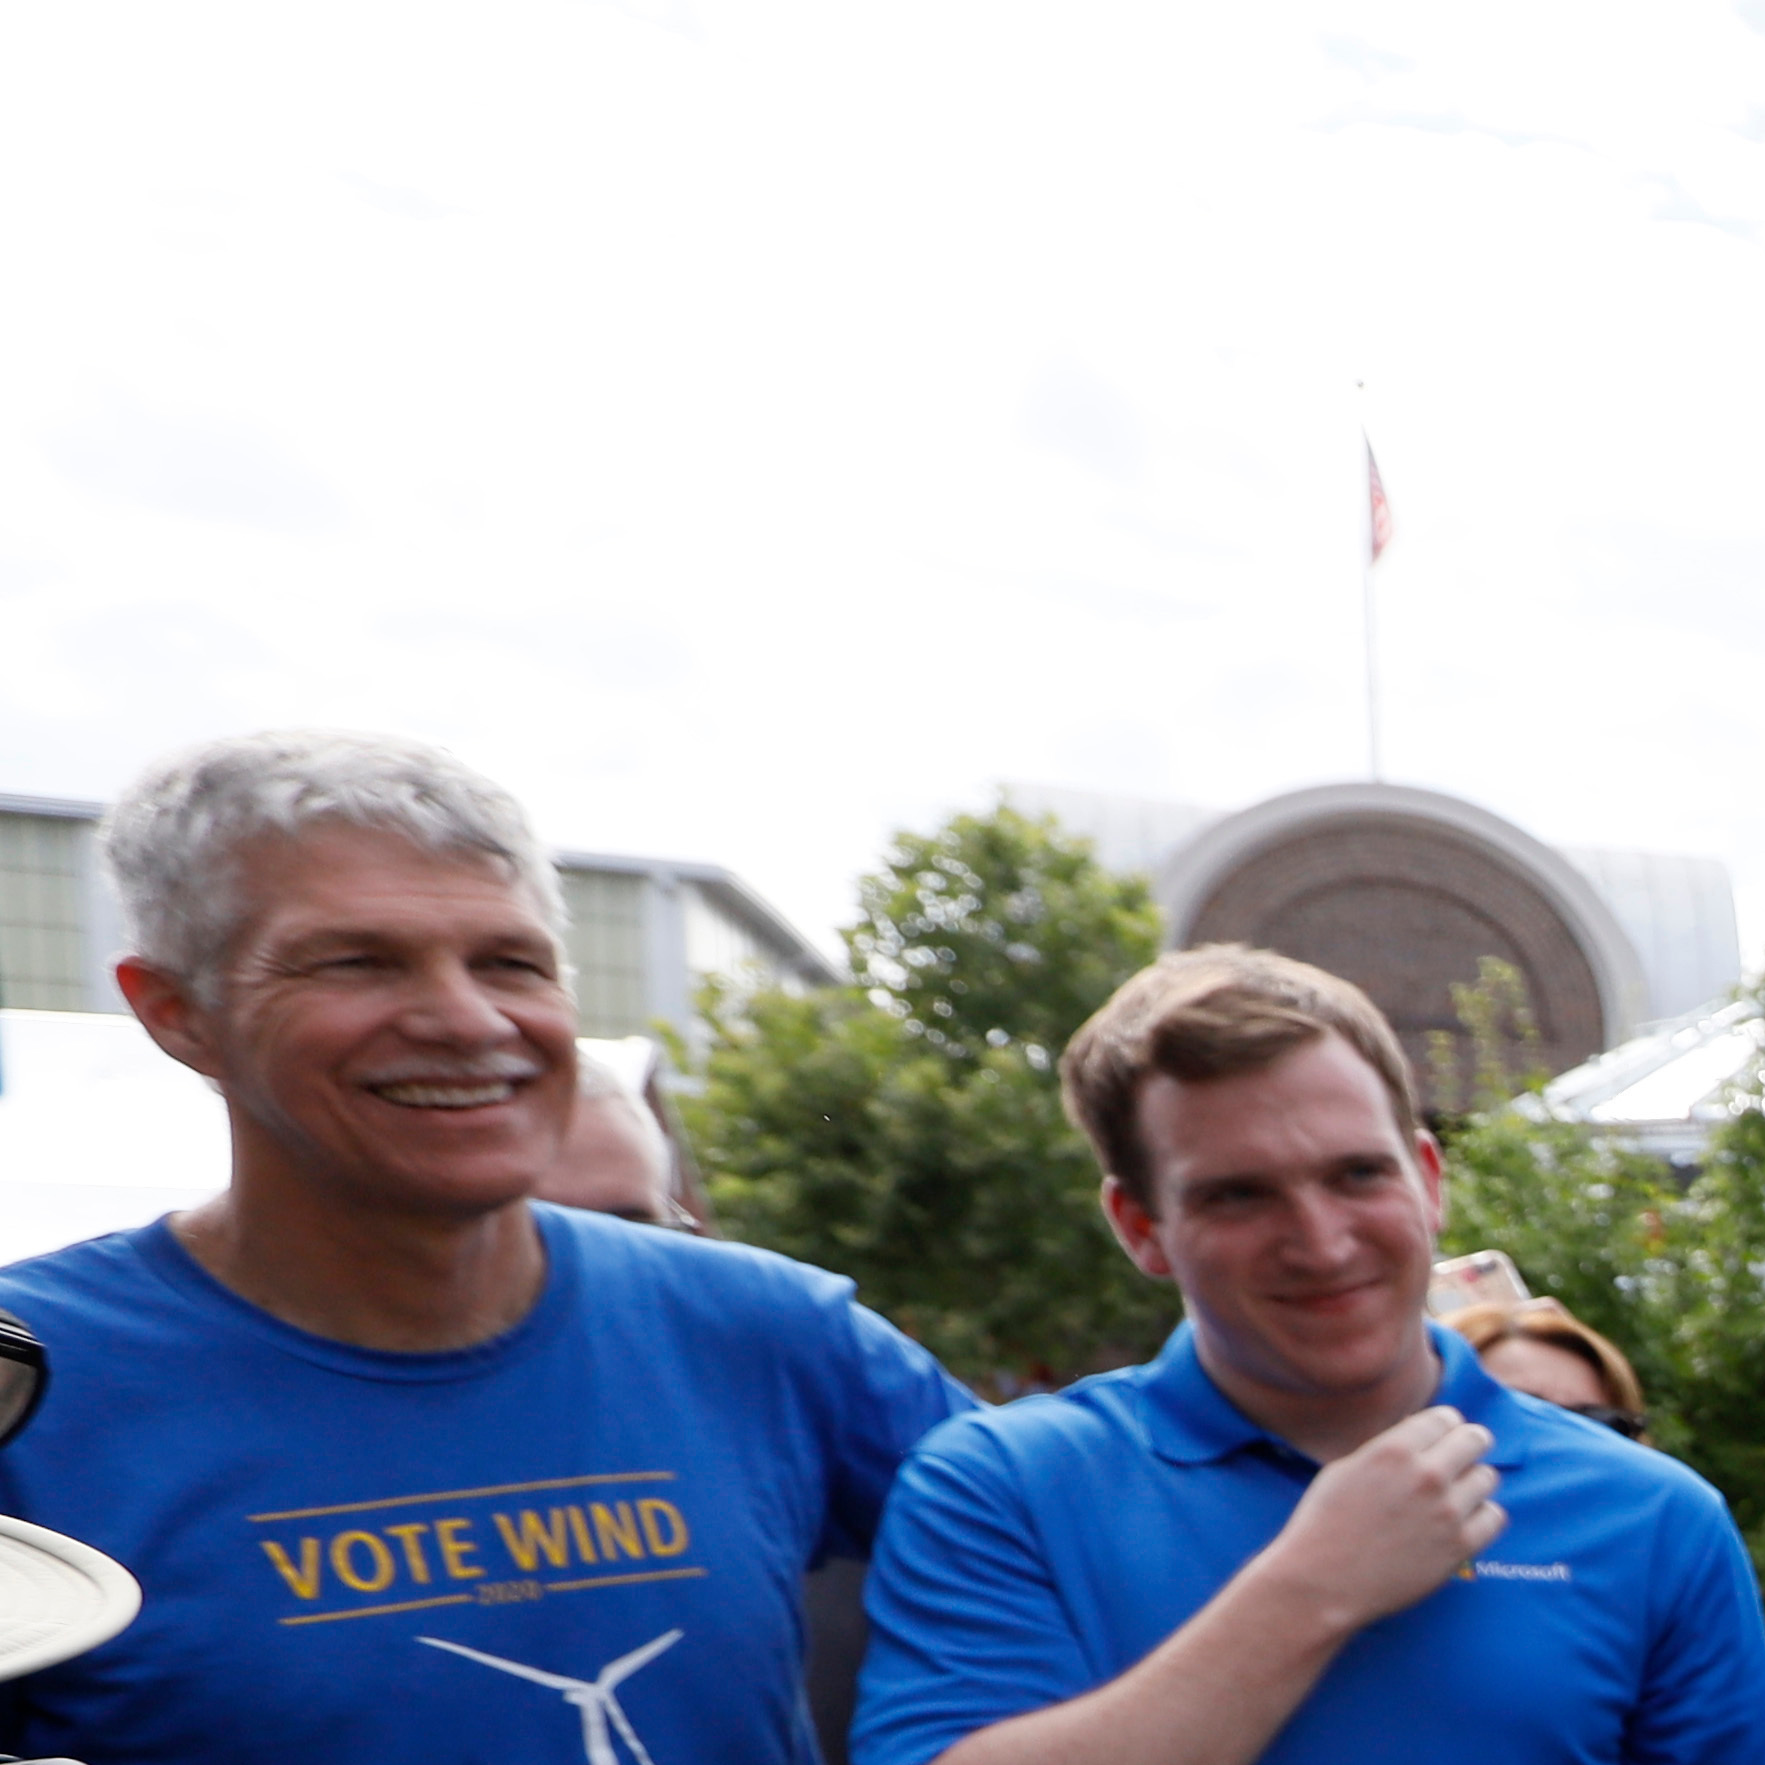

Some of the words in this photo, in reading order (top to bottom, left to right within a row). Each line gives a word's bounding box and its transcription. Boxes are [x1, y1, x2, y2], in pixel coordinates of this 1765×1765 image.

[262, 1516, 486, 1600] VOTE
[494, 1497, 689, 1572] WIND
[1475, 1560, 1571, 1581] Microsoft
